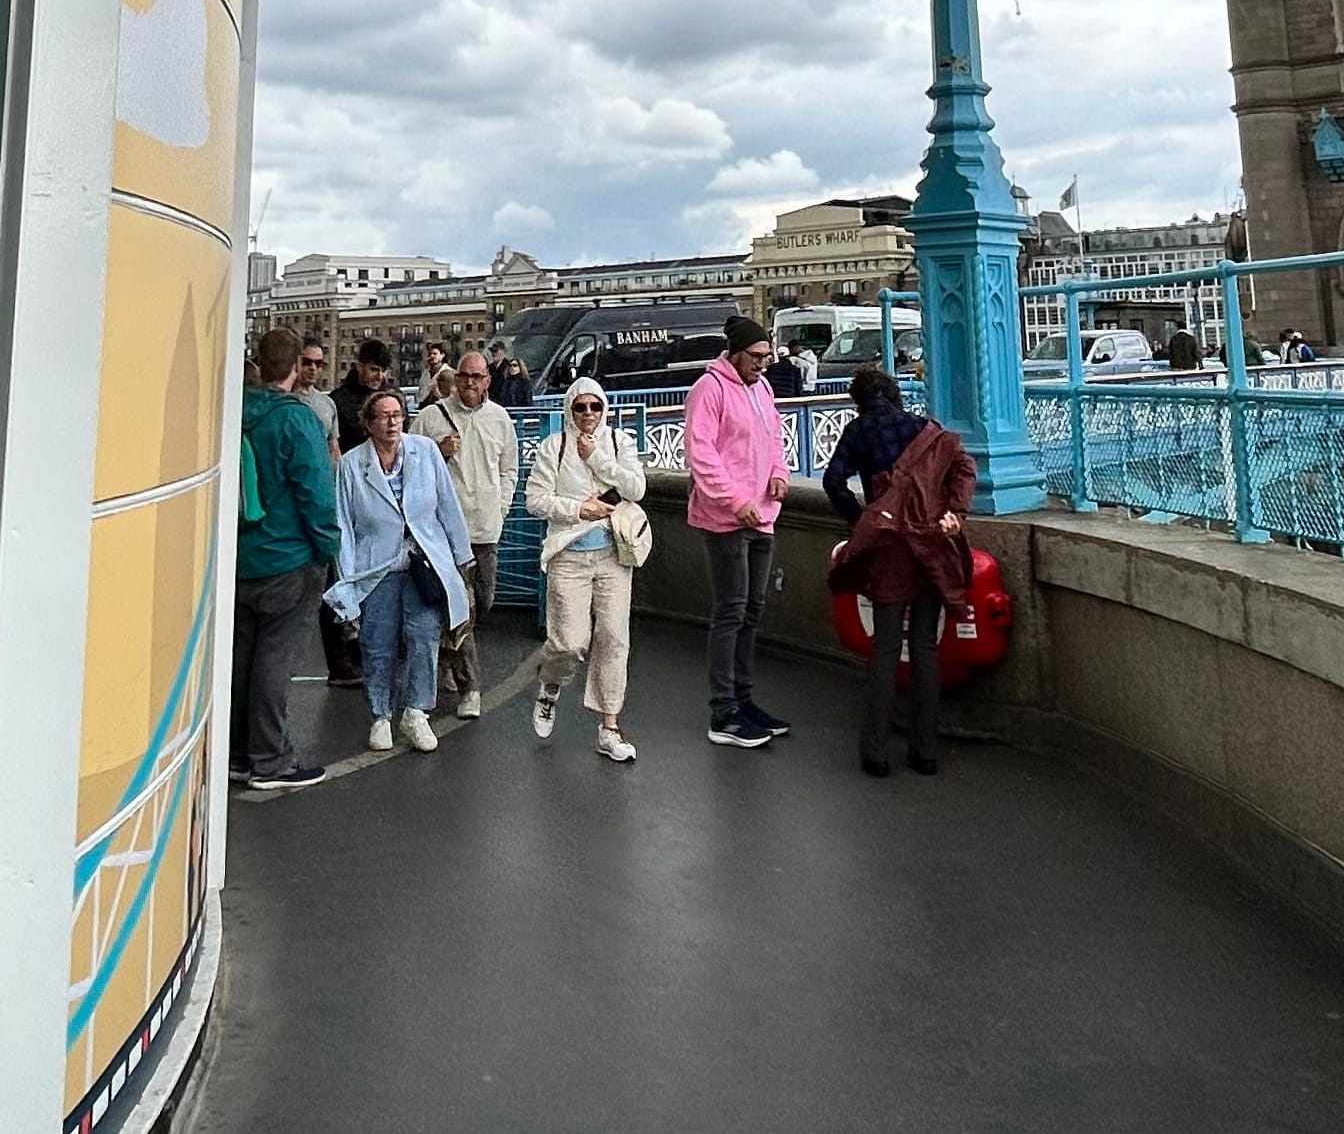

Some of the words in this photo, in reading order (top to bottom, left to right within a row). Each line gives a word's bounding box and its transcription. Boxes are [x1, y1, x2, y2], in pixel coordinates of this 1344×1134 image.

[776, 233, 822, 250] BUTLERS
[824, 229, 860, 246] WHARF
[616, 329, 669, 345] BANHAM
